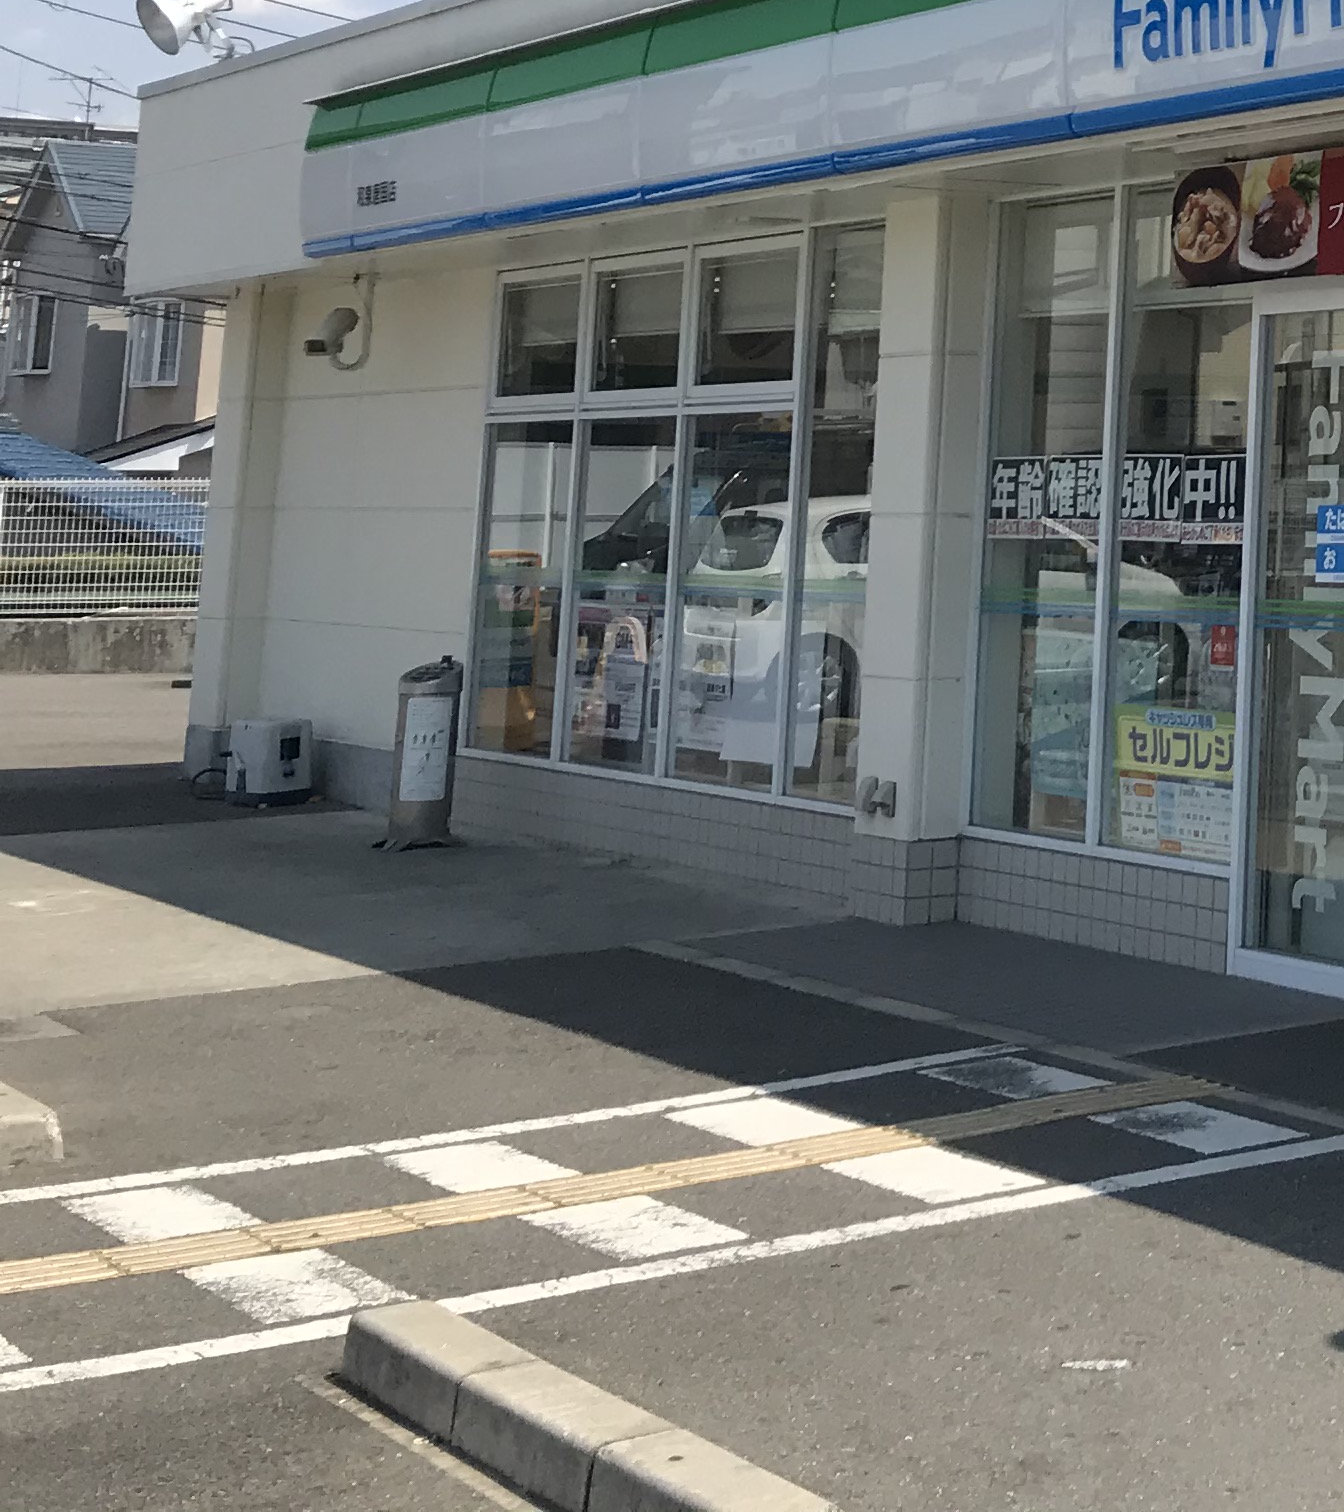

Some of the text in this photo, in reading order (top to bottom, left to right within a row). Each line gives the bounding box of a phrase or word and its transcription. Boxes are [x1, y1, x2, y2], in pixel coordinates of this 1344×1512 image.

[1128, 725, 1234, 772] セルフレジ
